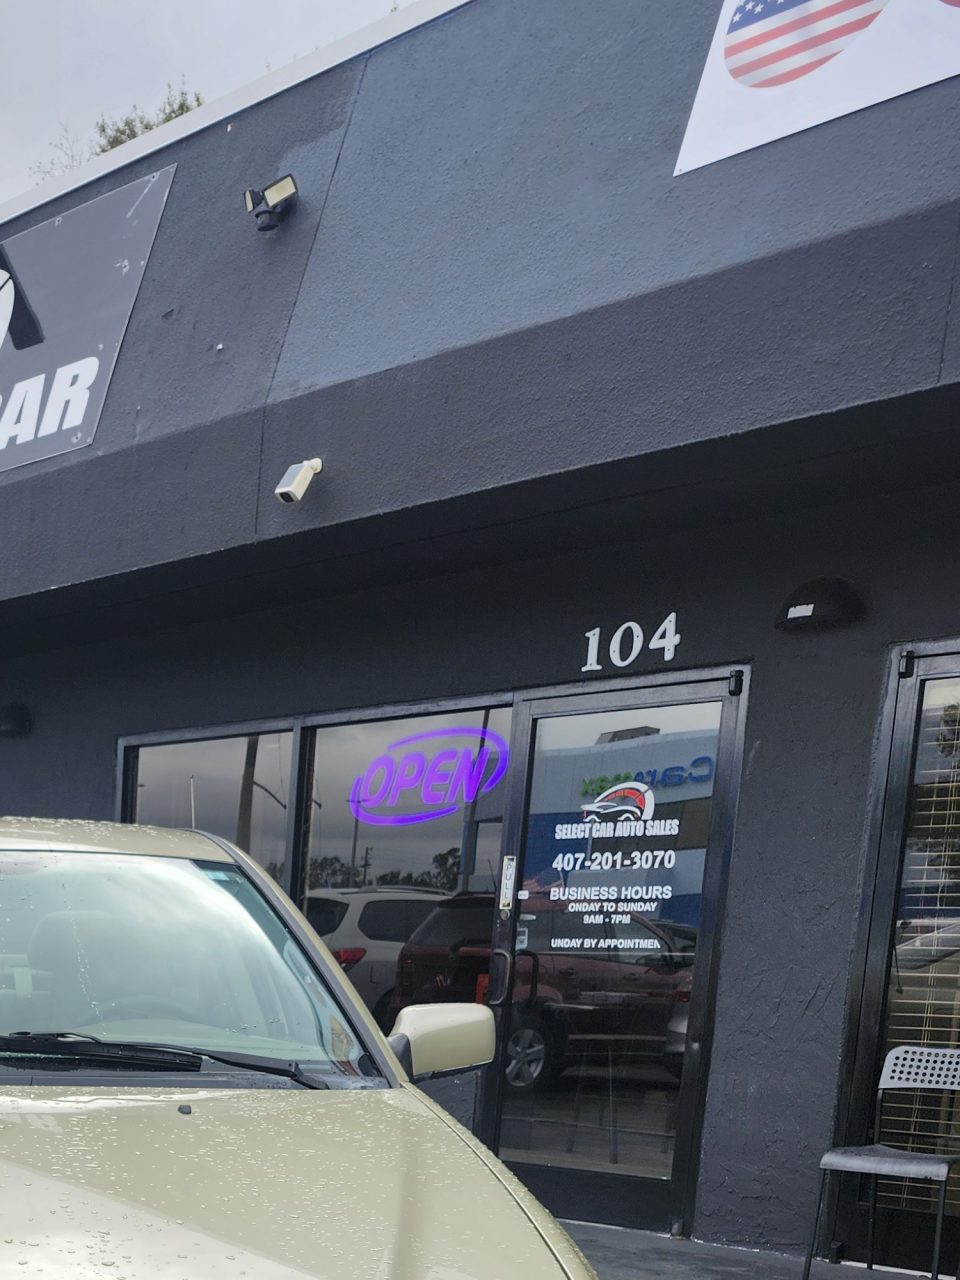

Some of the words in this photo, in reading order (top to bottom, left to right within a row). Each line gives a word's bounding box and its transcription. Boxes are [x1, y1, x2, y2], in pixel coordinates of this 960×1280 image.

[581, 612, 681, 672] 104
[360, 747, 491, 809] OPEN
[555, 823, 591, 840] SELECT
[591, 821, 614, 838] CAR
[614, 820, 645, 837] AUTO
[645, 818, 680, 836] SALES
[552, 850, 676, 871] 407-201-3070
[504, 863, 512, 899] PULL
[550, 886, 618, 900] BUSINESS
[621, 885, 673, 899] HOURS
[568, 902, 601, 913] ONDAY
[602, 902, 616, 912] TO
[617, 902, 658, 912] SUNDAY
[583, 914, 604, 924] 9AM
[610, 914, 631, 924] 7PM
[551, 939, 582, 948] UNDAY
[583, 939, 596, 948] BY
